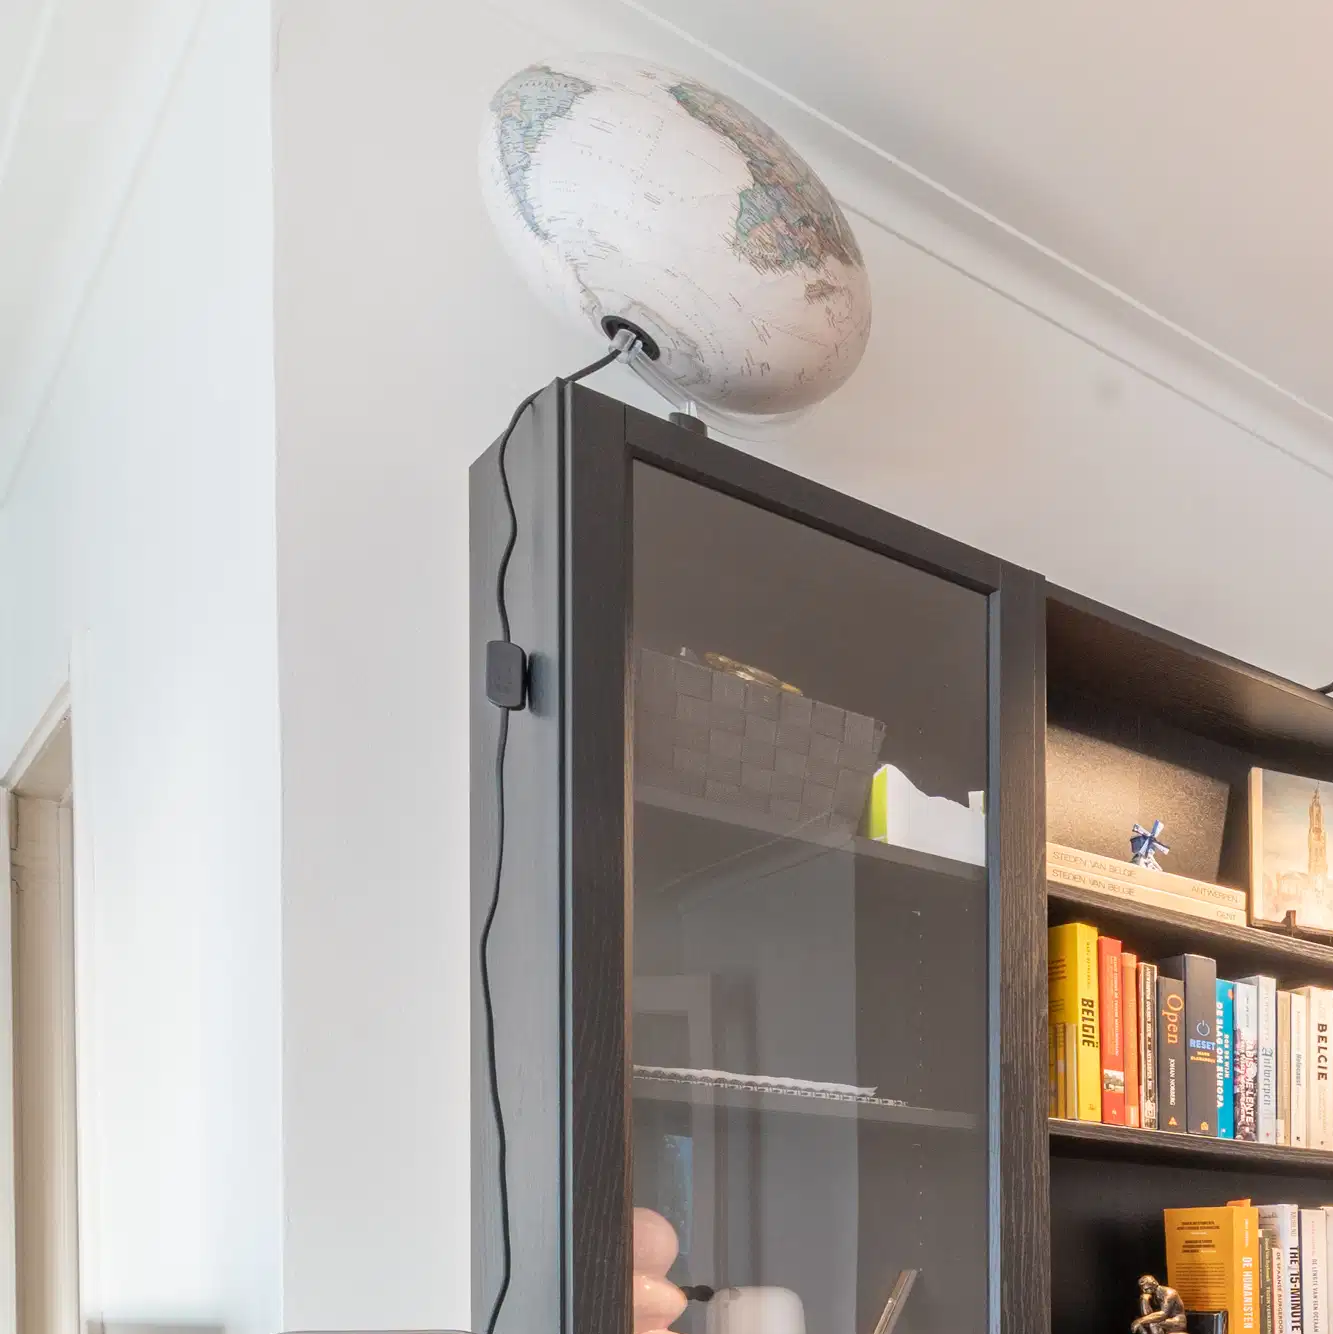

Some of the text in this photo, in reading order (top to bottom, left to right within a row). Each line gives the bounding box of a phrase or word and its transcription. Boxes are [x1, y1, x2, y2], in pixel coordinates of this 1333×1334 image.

[1053, 851, 1087, 868] STEDEN
[1090, 860, 1107, 872] VAN
[1191, 884, 1239, 904] ANTWERPEN
[1081, 998, 1098, 1048] BELGIË
[1161, 993, 1185, 1044] Open
[1189, 1039, 1216, 1051] RESET
[1216, 1002, 1225, 1109] DE SLAG OM EUROPA
[1168, 1058, 1177, 1106] JOHAN NORBERG
[1261, 1047, 1273, 1106] Antwerpen
[1242, 1257, 1252, 1269] DE
[1289, 1246, 1299, 1266] THE
[1243, 1271, 1253, 1329] HUMANISTEN
[1289, 1272, 1301, 1331] 15-MINUTE
